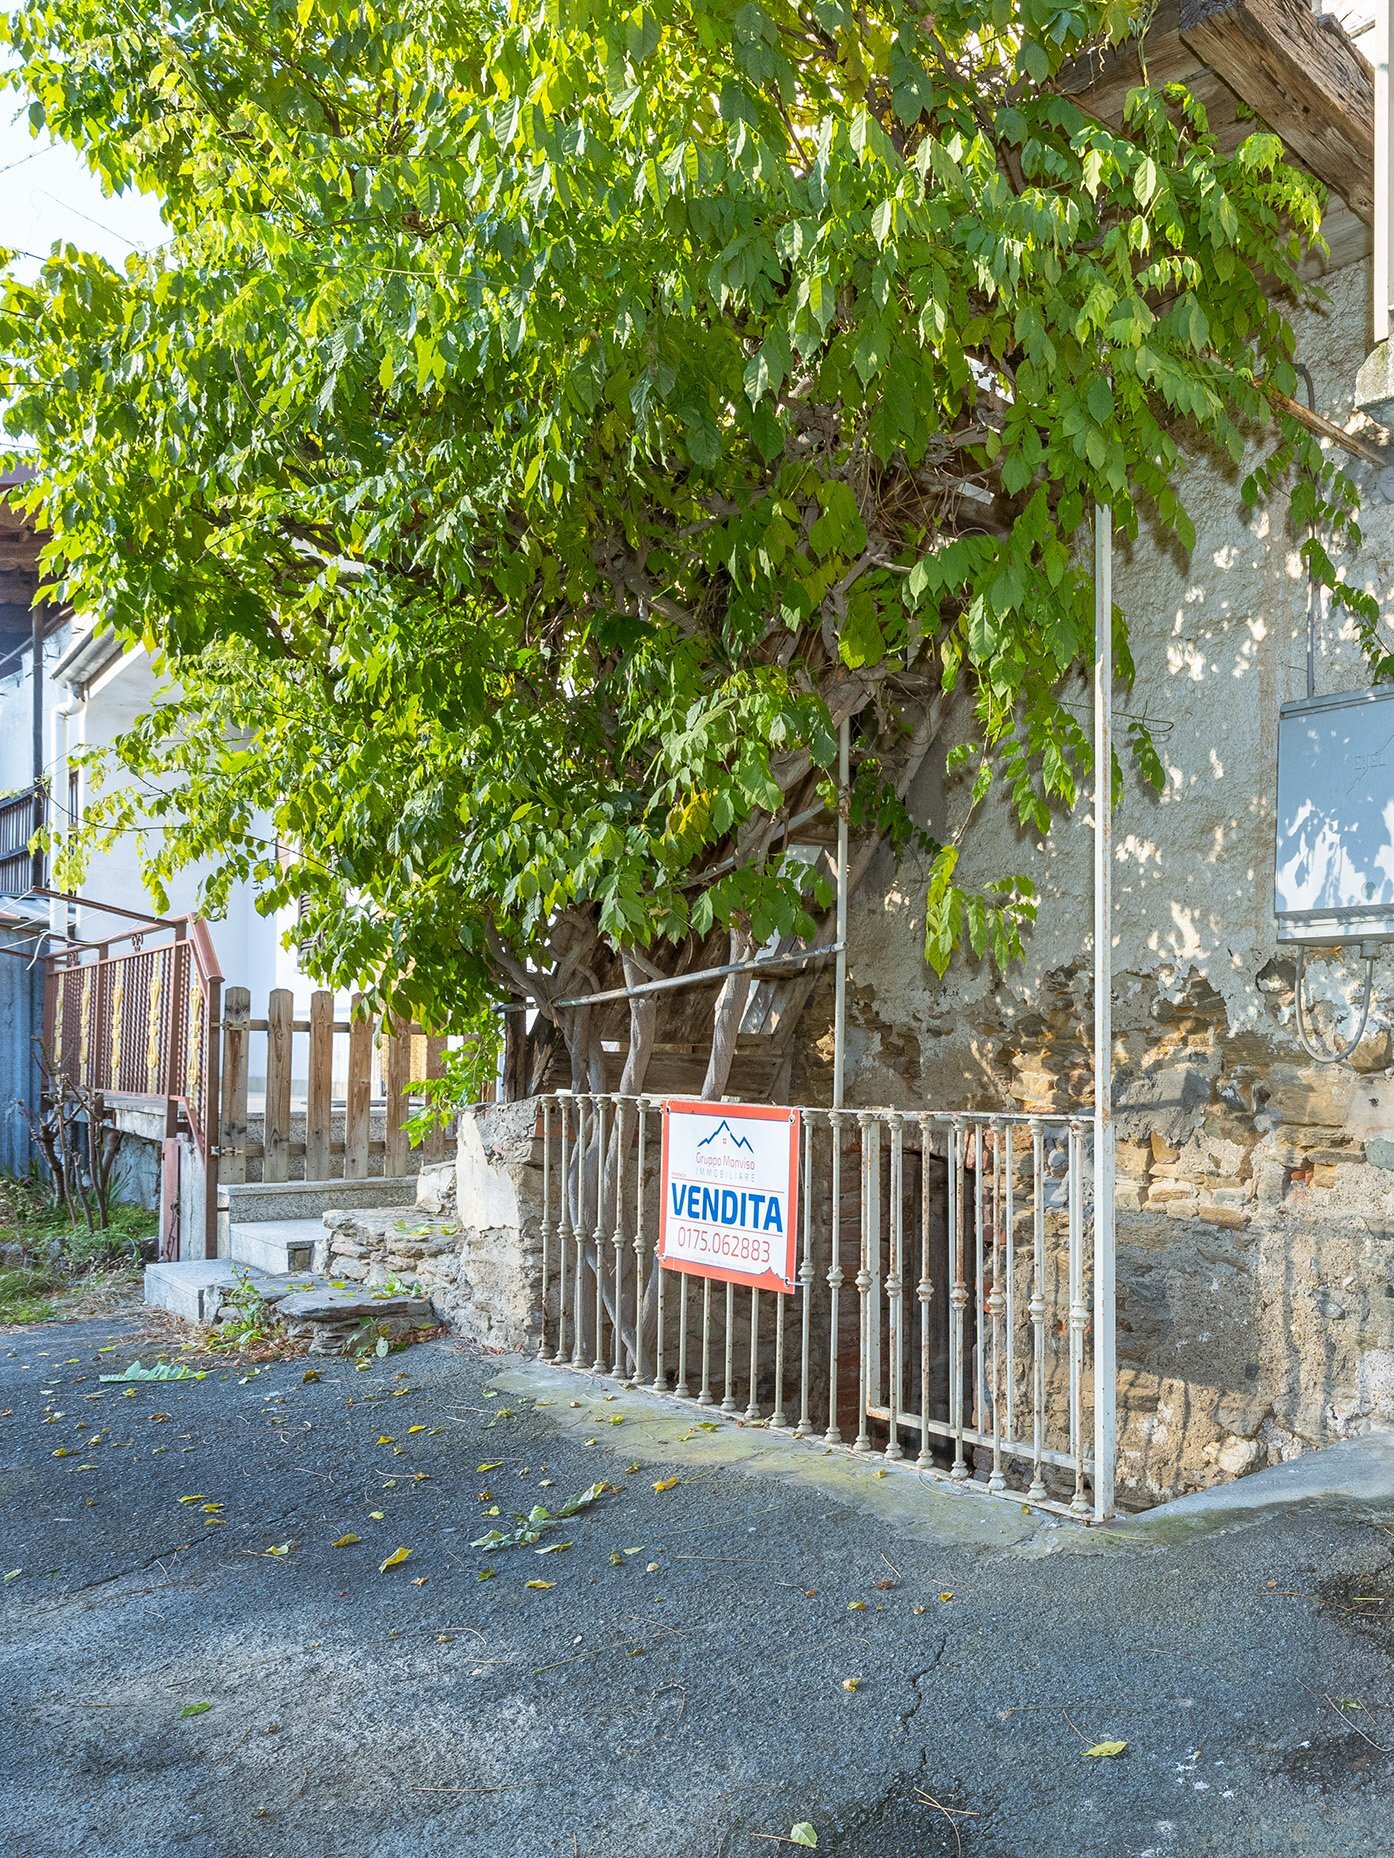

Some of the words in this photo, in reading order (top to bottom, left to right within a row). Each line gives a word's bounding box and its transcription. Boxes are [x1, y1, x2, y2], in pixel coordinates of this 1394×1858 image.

[695, 1167, 755, 1183] IMMOBILIARE
[696, 1152, 722, 1168] Gruppo
[723, 1155, 756, 1171] Monviso
[671, 1183, 783, 1233] VENDITA
[678, 1226, 771, 1263] 0175.062883
